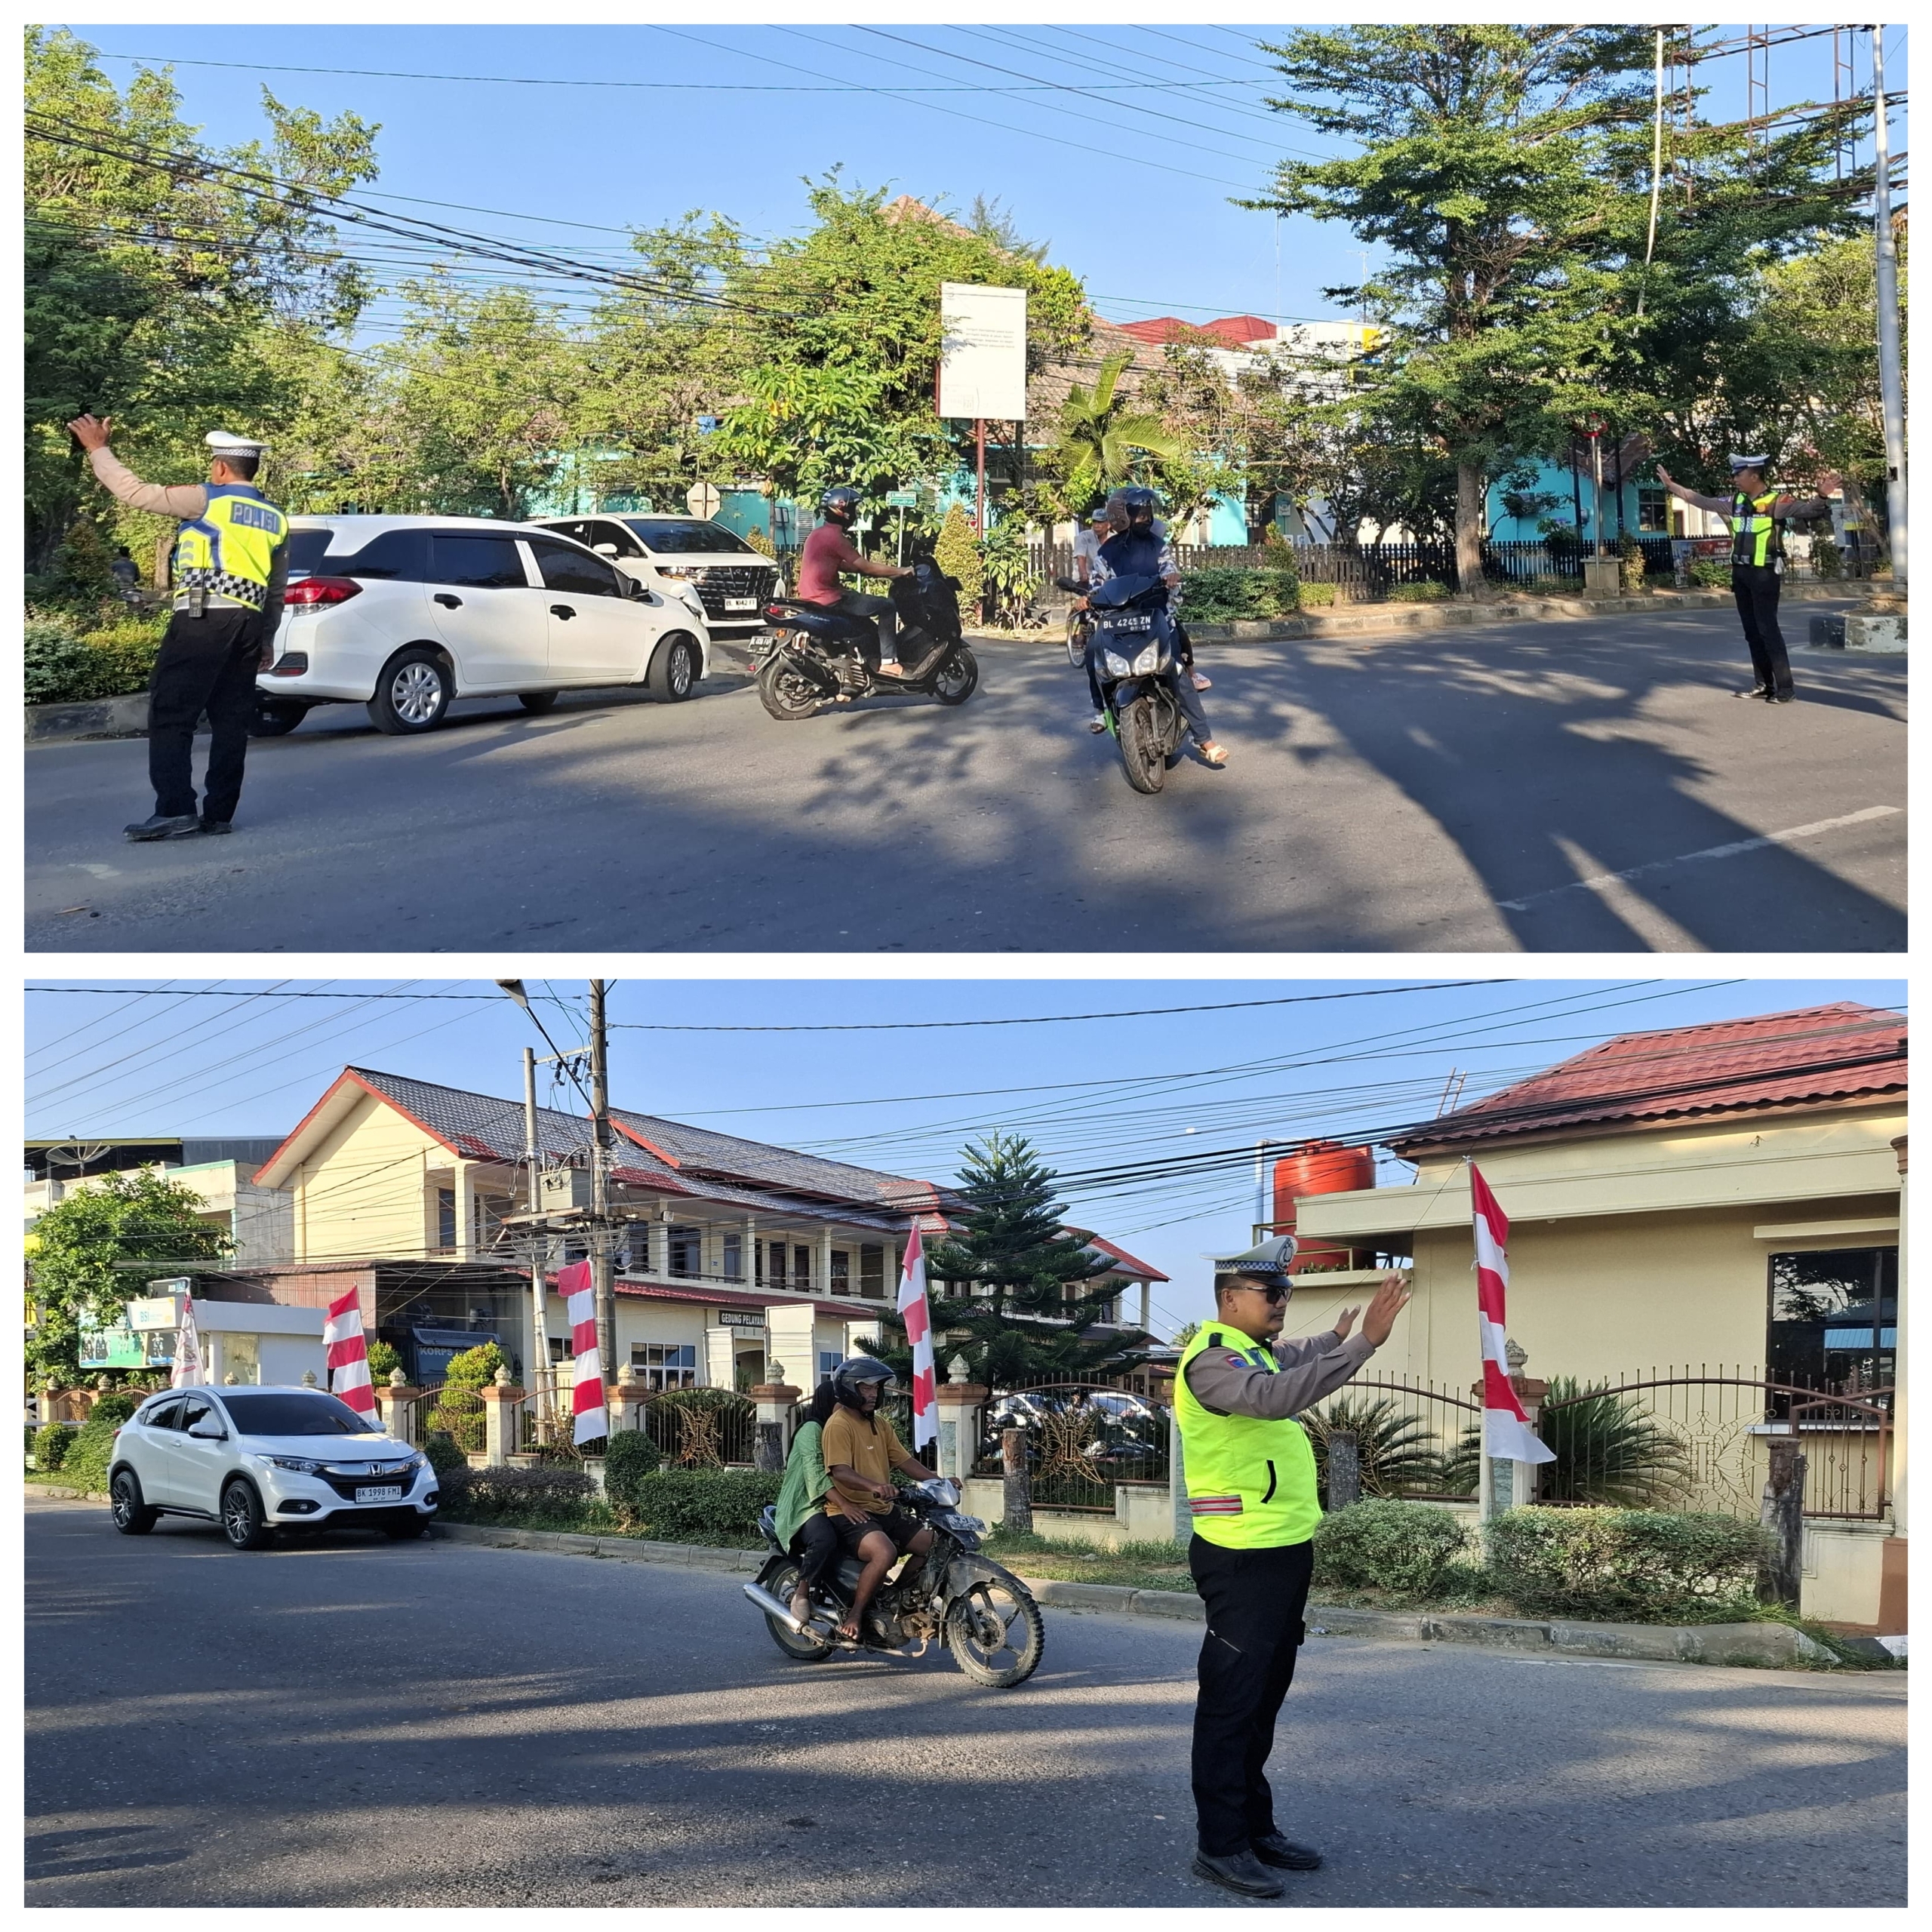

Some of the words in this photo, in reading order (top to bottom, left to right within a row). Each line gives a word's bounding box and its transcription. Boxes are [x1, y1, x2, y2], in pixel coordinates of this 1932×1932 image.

[233, 503, 278, 532] POLISI
[1103, 620, 1113, 629] BL
[1117, 617, 1138, 627] 4245
[1140, 616, 1151, 625] ZN
[721, 1313, 742, 1324] GEDUNG
[420, 1346, 453, 1356] KORPS
[357, 1489, 366, 1497] BK
[368, 1487, 386, 1497] 1998
[388, 1487, 401, 1496] FMI
